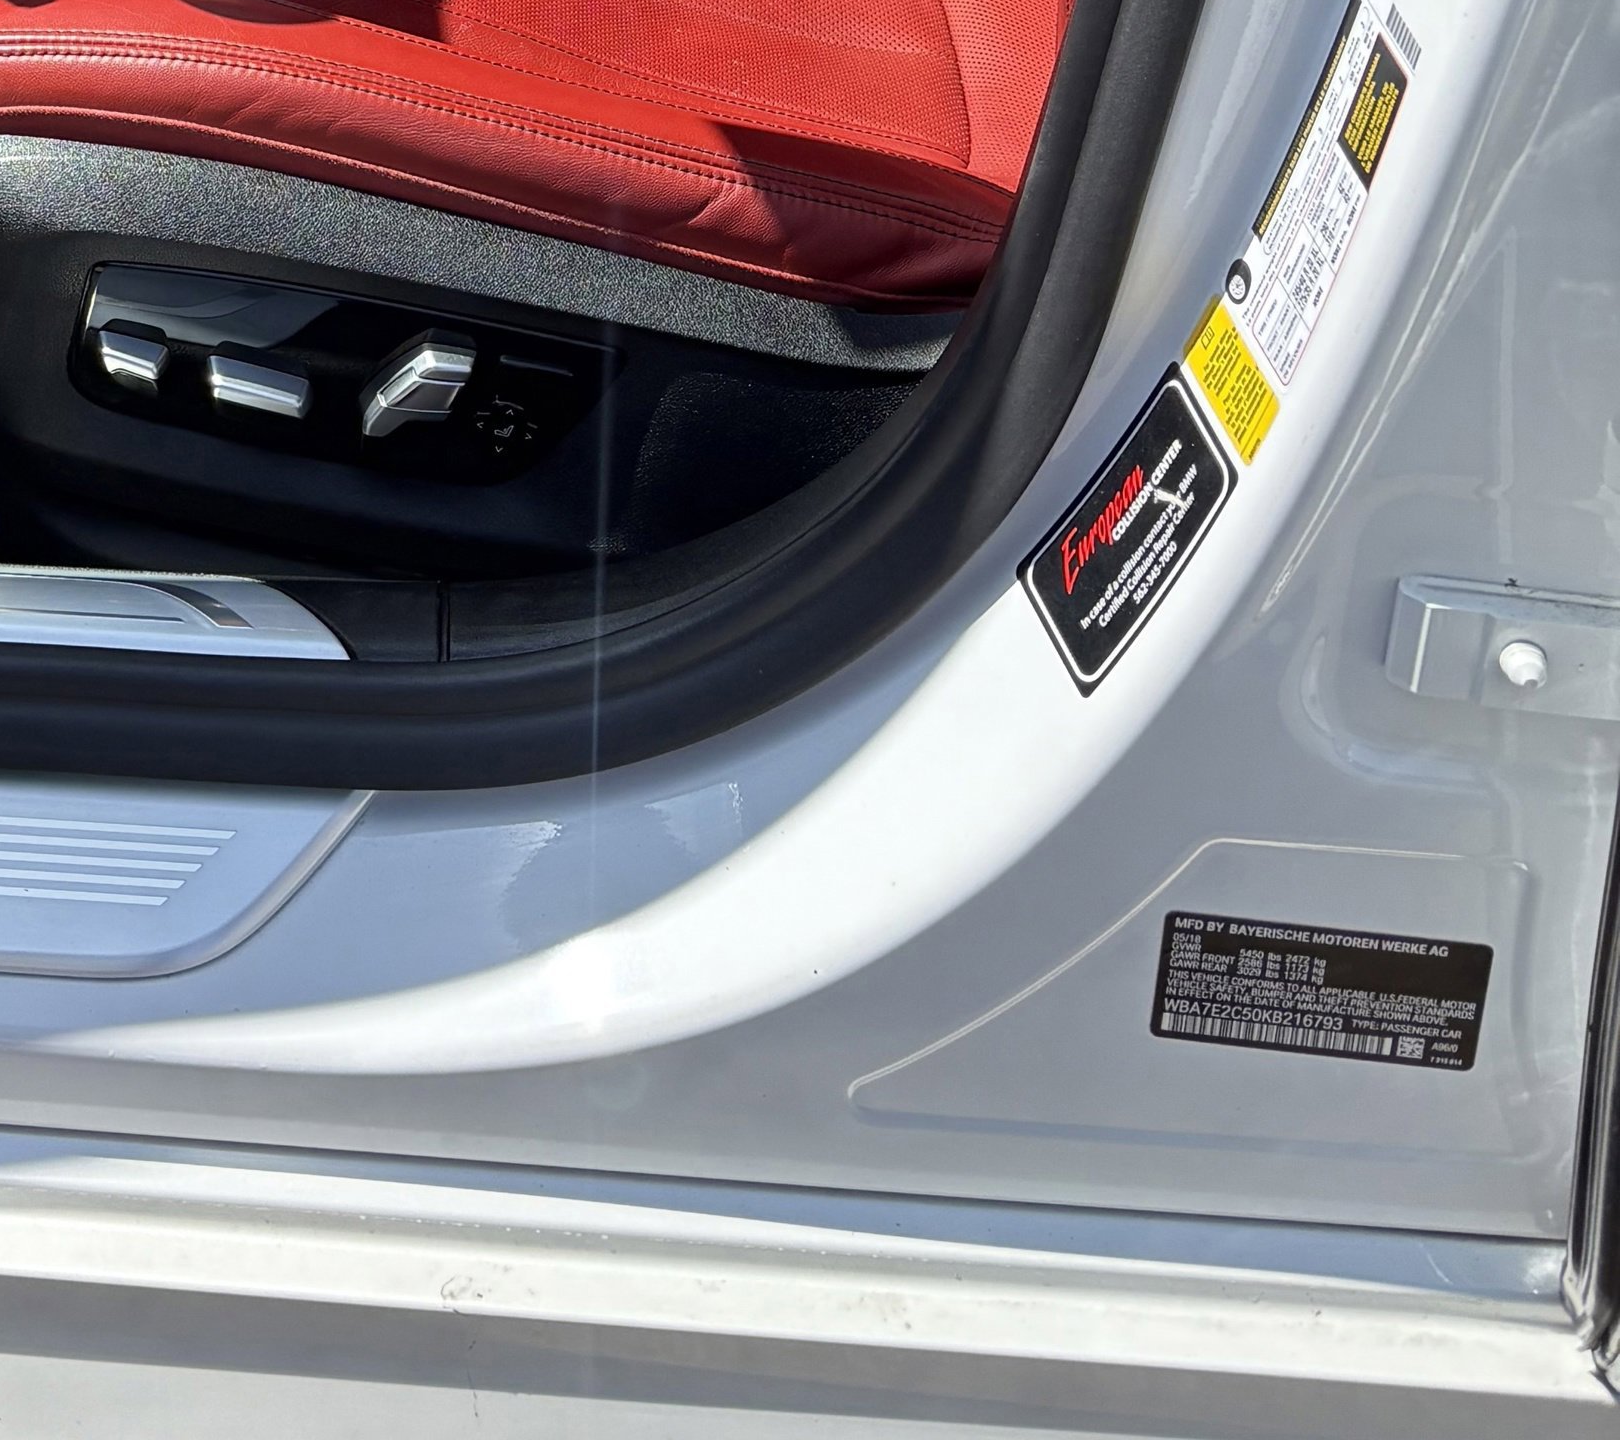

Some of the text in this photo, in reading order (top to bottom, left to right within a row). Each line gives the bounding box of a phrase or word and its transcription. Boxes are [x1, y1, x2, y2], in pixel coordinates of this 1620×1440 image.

[1112, 439, 1182, 541] COLLISION CENTER
[1062, 468, 1143, 593] European
[1081, 617, 1091, 629] In
[1089, 598, 1106, 619] case
[1105, 584, 1114, 600] of
[1113, 581, 1119, 590] a
[1118, 546, 1145, 583] collision
[1143, 512, 1168, 548] contact
[1179, 464, 1197, 494] BMW
[1099, 586, 1129, 627] Certified
[1127, 552, 1156, 590] Collision
[1153, 519, 1177, 553] Repair
[1133, 541, 1177, 604] 562-345-7000
[1170, 941, 1327, 969] GVWR 5450 lbs 2472 kg
[1171, 932, 1202, 944] 05/18
[1174, 916, 1450, 957] MFD BY BAYERISCHE MOTOREN WERKE AG
[1168, 958, 1324, 985] GAWR REAR 3029 lbs 1374 kg
[1169, 949, 1201, 961] GAWR
[1201, 953, 1235, 965] FRONT
[1265, 960, 1281, 970] lbs
[1284, 962, 1310, 973] 1173
[1311, 965, 1326, 977] kg
[1164, 986, 1450, 1027] IN EFFECT ON THE DATE OF MANUFACTURE SHOWN ABOVE.
[1166, 978, 1208, 991] VEHICLE
[1250, 987, 1293, 1000] BUMPER
[1293, 992, 1317, 1003] AND
[1321, 995, 1349, 1006] THEFT
[1350, 998, 1414, 1013] PREVENTION
[1414, 1005, 1476, 1020] STANDARDS
[1167, 969, 1189, 980] THIS
[1190, 972, 1230, 984] VEHICLE
[1230, 976, 1285, 991] CONFORMS
[1286, 982, 1300, 992] TO
[1300, 984, 1317, 994] ALL
[1318, 986, 1376, 1001] APPLICABLE
[1439, 999, 1477, 1012] MOTOR
[1162, 997, 1344, 1031] WBA7E2C50KB216793
[1350, 1018, 1462, 1040] TYPE: PASSENGER CAR
